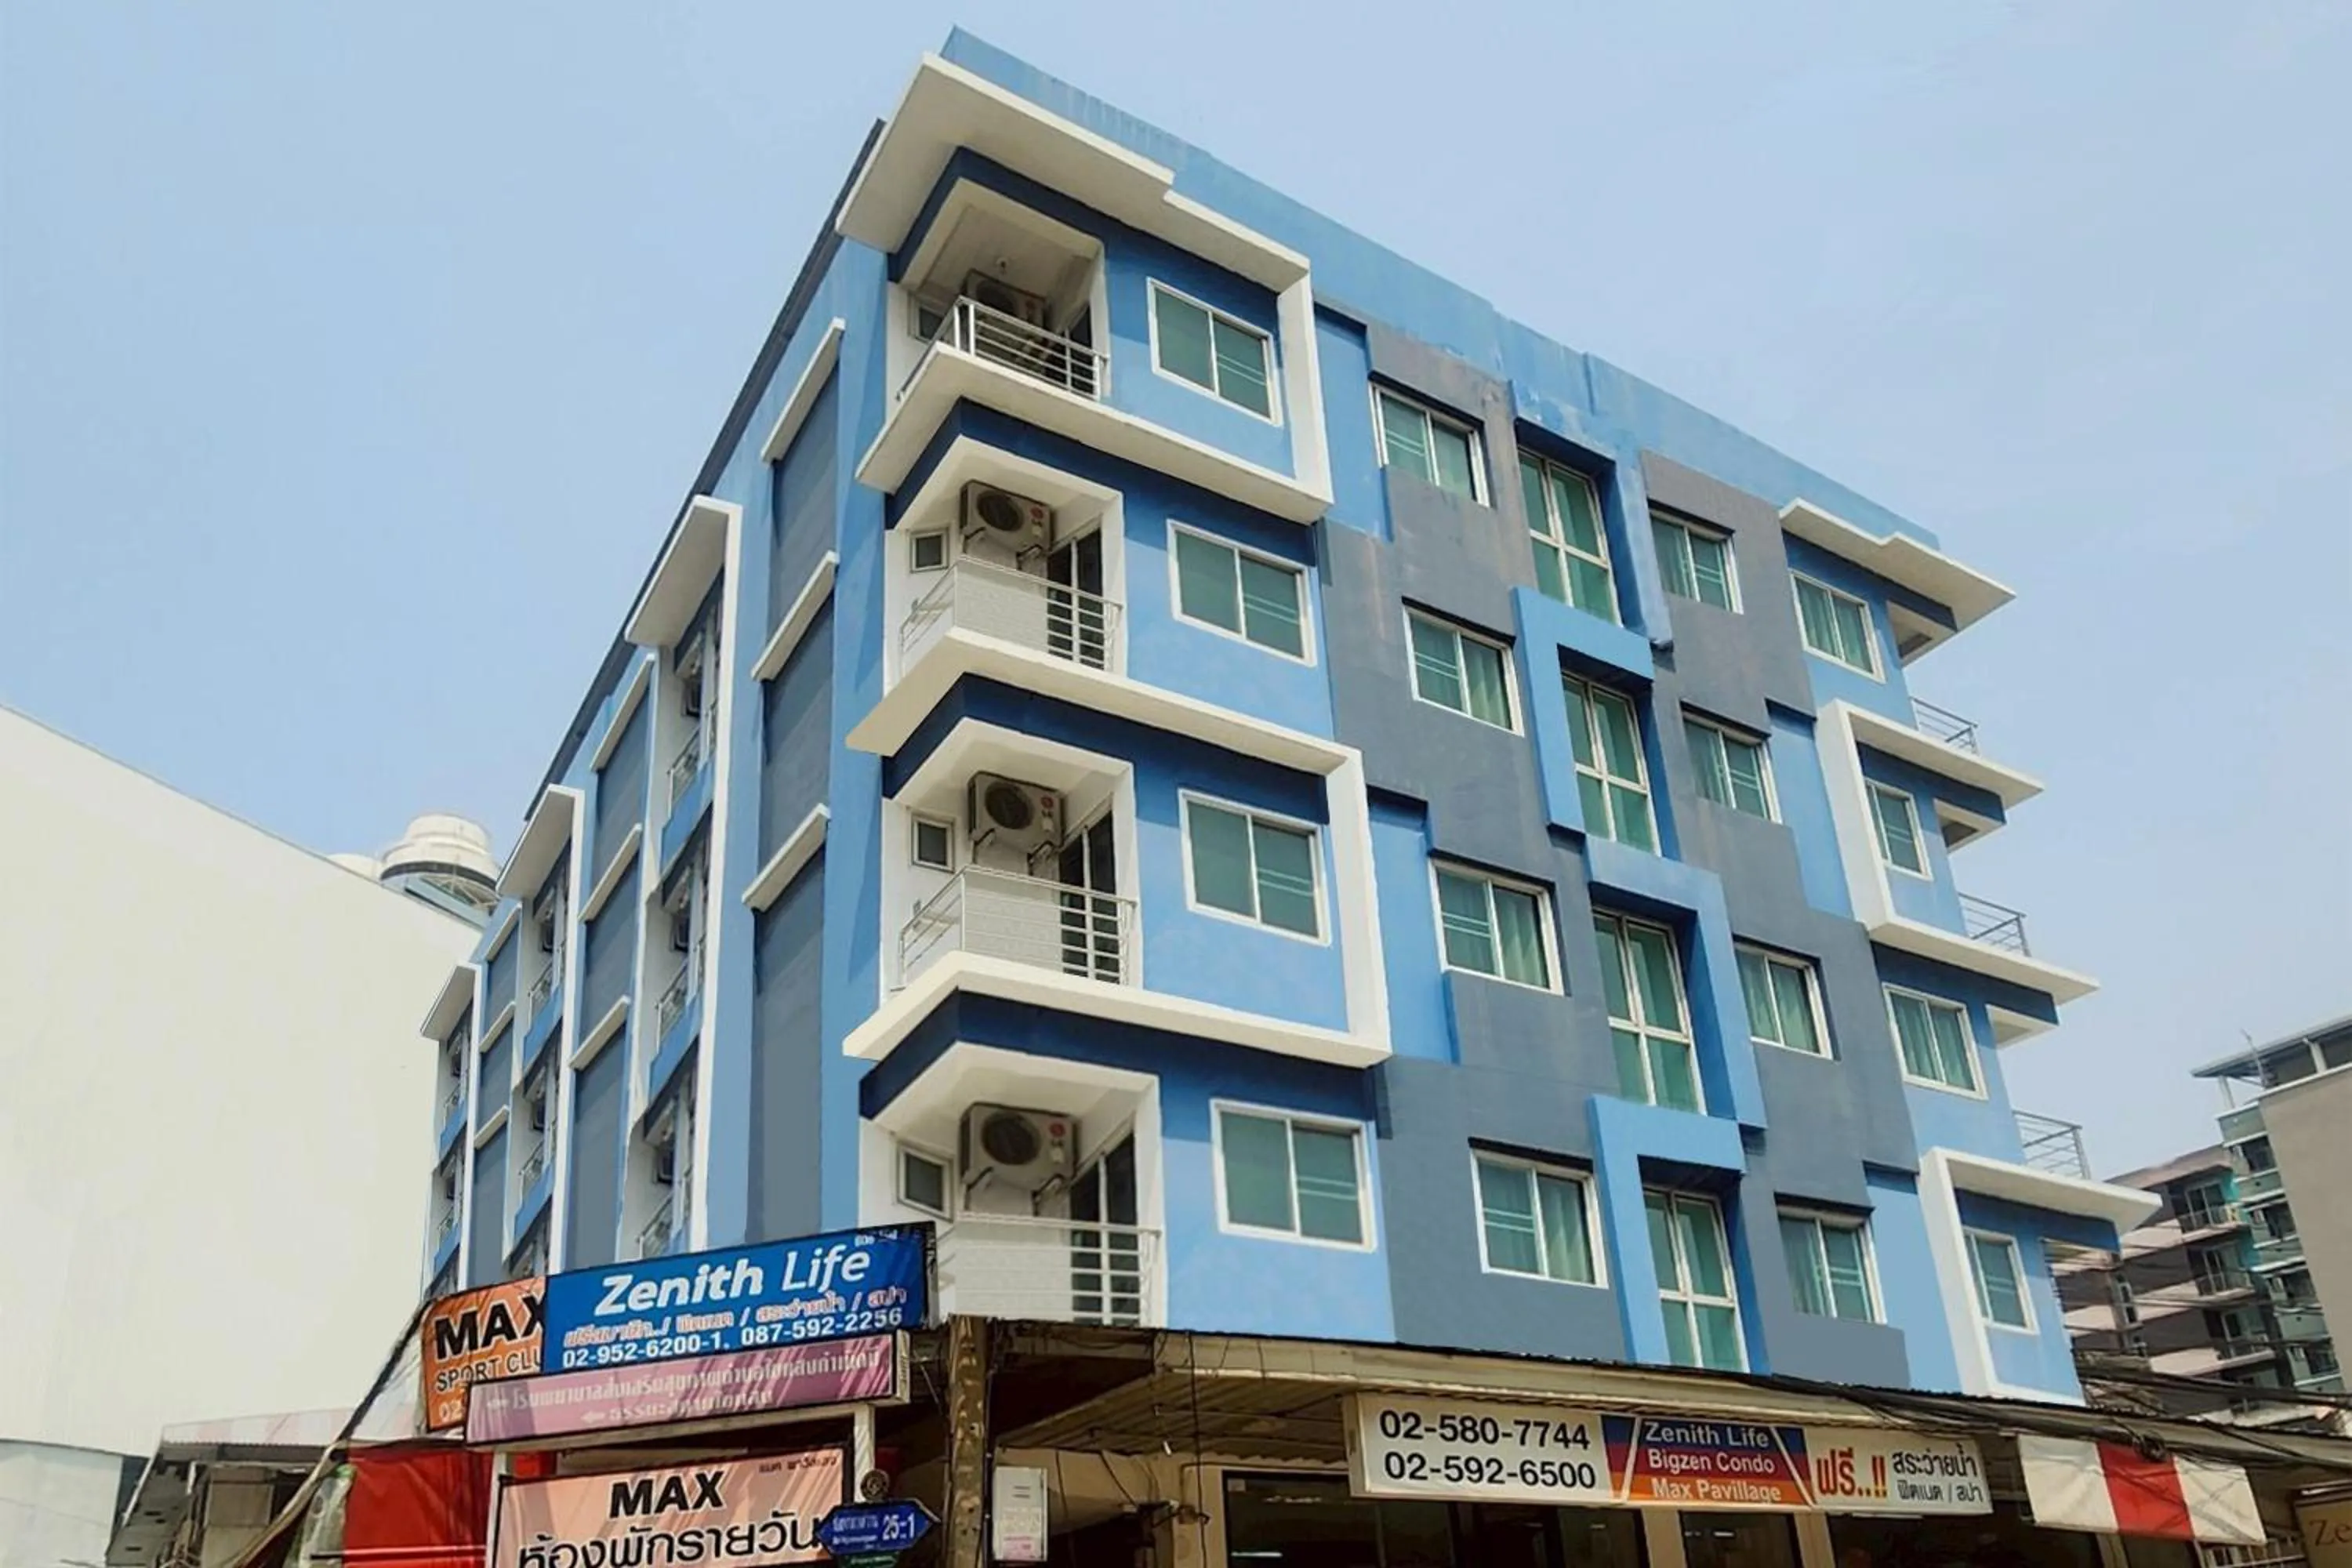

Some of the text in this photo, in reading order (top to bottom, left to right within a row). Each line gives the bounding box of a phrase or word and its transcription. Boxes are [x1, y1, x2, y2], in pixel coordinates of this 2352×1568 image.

[594, 1243, 871, 1316] Zenith Life
[434, 1294, 545, 1360] MAX
[741, 1307, 903, 1346] 087-592-2256
[436, 1354, 500, 1392] SPORT
[1380, 1410, 1591, 1450] 02-580-7744
[1645, 1421, 1770, 1448] Zenith Life
[1385, 1451, 1596, 1489] 02-592-6500
[1647, 1447, 1776, 1475] Bigzen Condo
[1891, 1443, 1978, 1478] สระว่ายน้ำ
[609, 1471, 724, 1518] MAX
[1650, 1476, 1783, 1503] Max Pavillage
[517, 1510, 819, 1568] ห้องพักรายวัน
[2308, 1519, 2352, 1547] Ze
